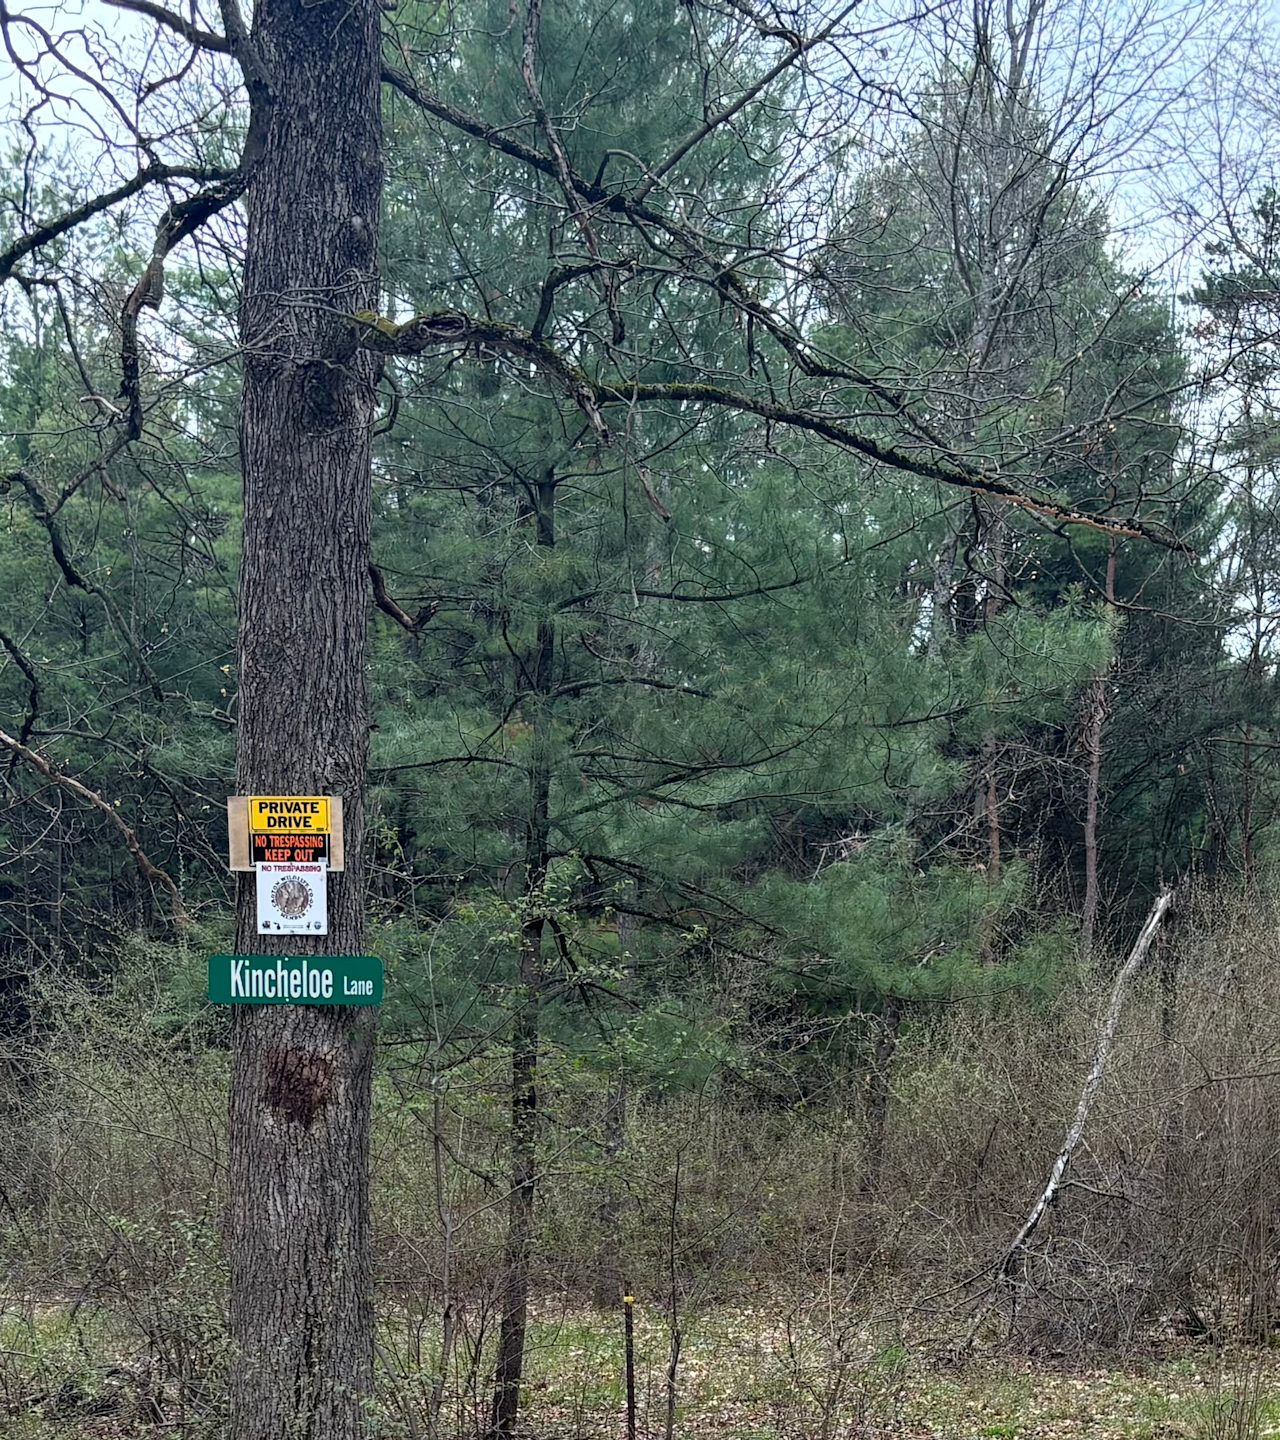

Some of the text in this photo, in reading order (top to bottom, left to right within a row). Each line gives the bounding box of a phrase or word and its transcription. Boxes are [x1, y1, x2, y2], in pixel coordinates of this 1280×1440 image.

[258, 801, 320, 814] PRIVATE
[267, 816, 312, 828] DRIVE
[255, 835, 324, 848] NO TRESPASSING
[265, 849, 314, 861] KEEP OUT
[230, 959, 374, 998] Kincheloe Lane
